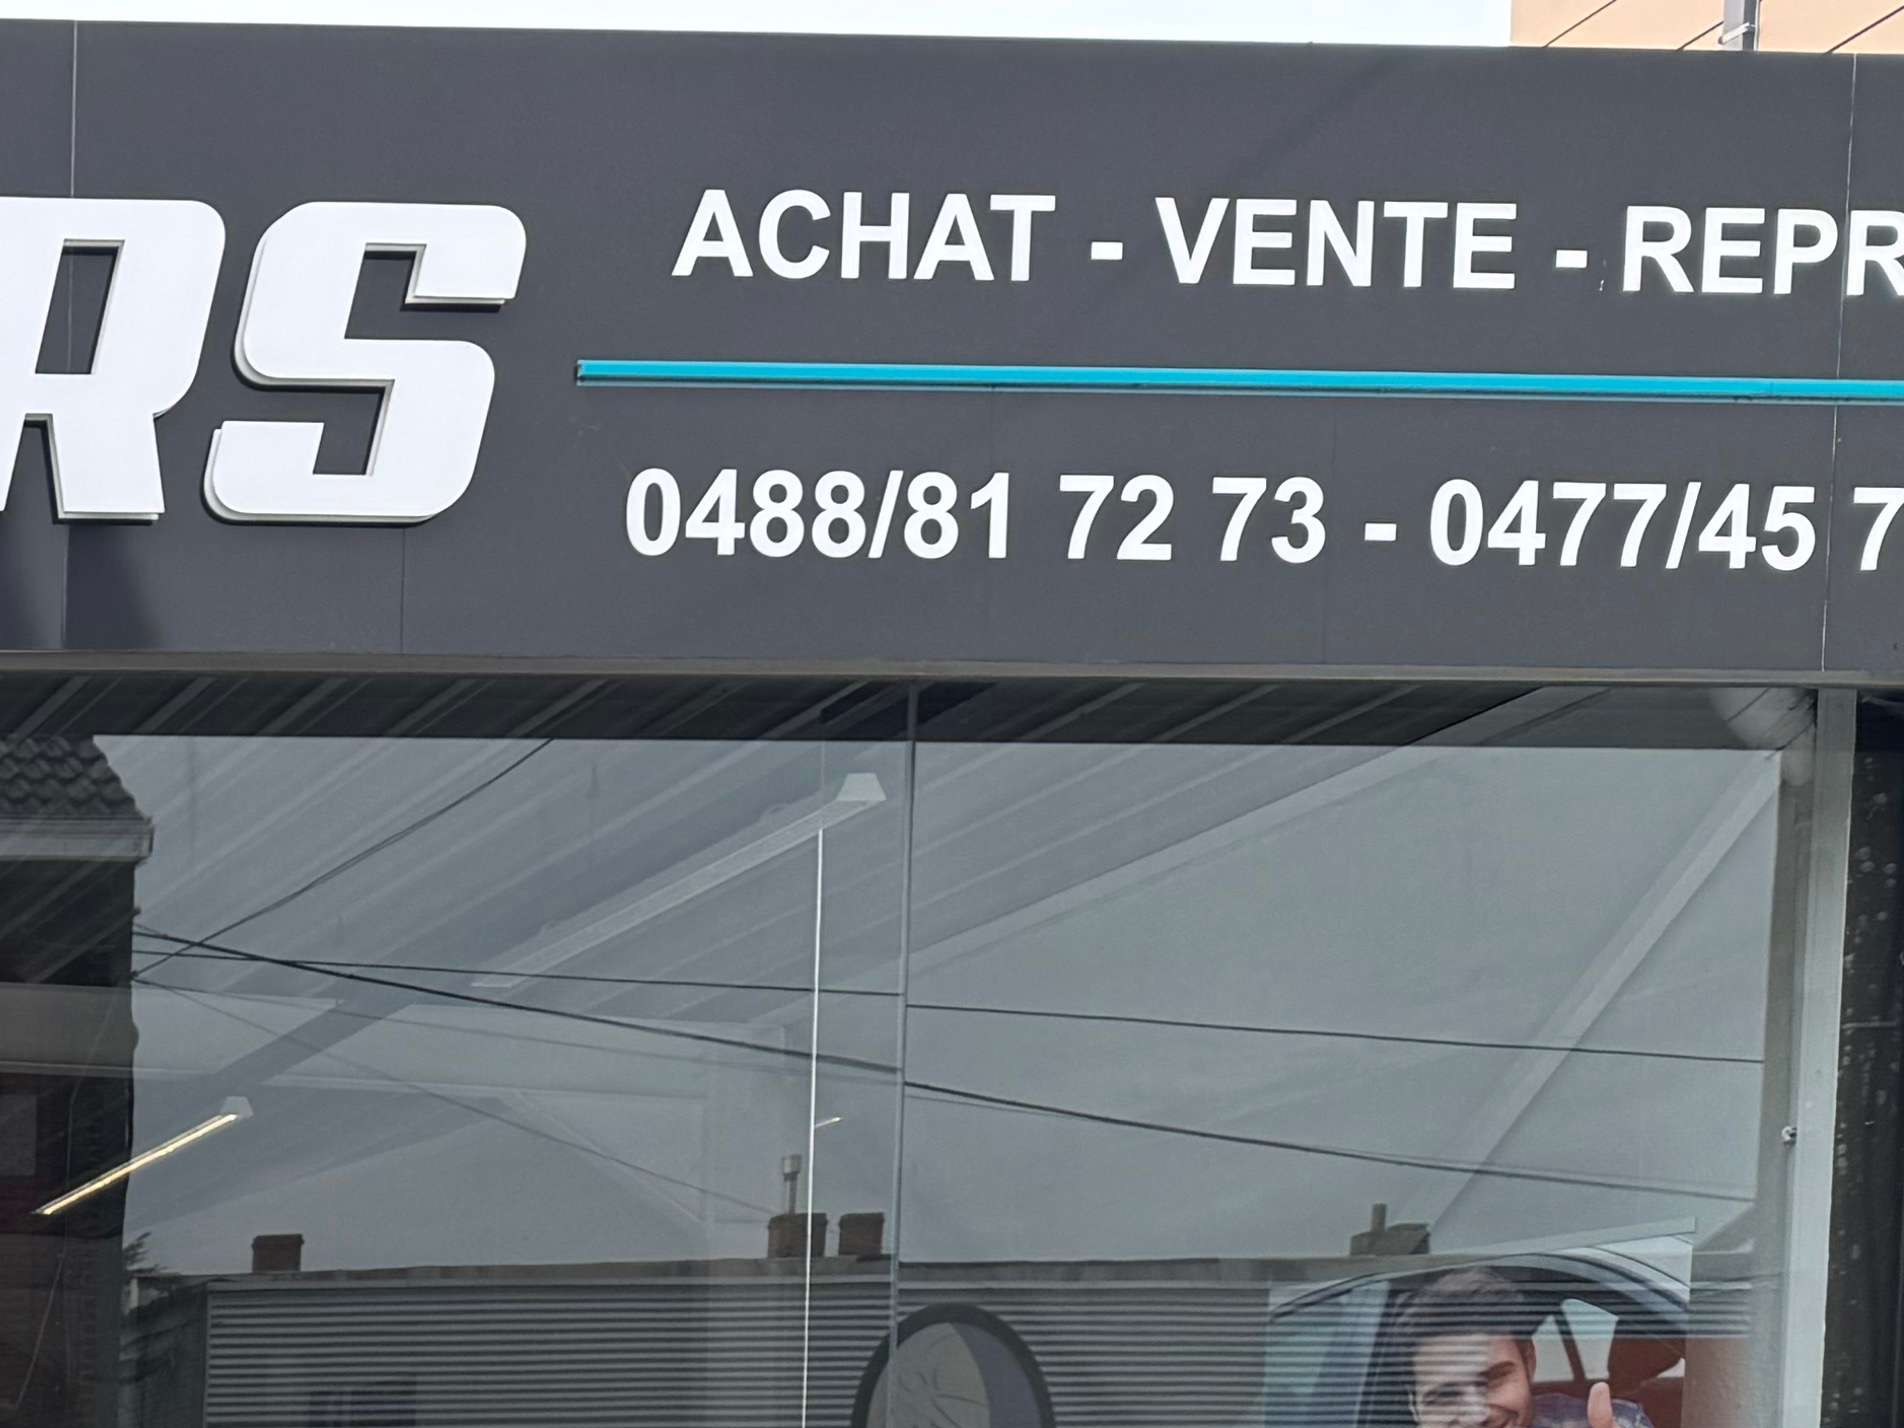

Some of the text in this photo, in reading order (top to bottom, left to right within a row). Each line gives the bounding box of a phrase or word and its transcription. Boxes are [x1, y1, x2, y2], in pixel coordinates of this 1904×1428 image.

[672, 188, 1904, 298] ACHAT - VENTE - REPR
[624, 467, 1904, 572] 0488/81 72 73 - 0477/45 7
